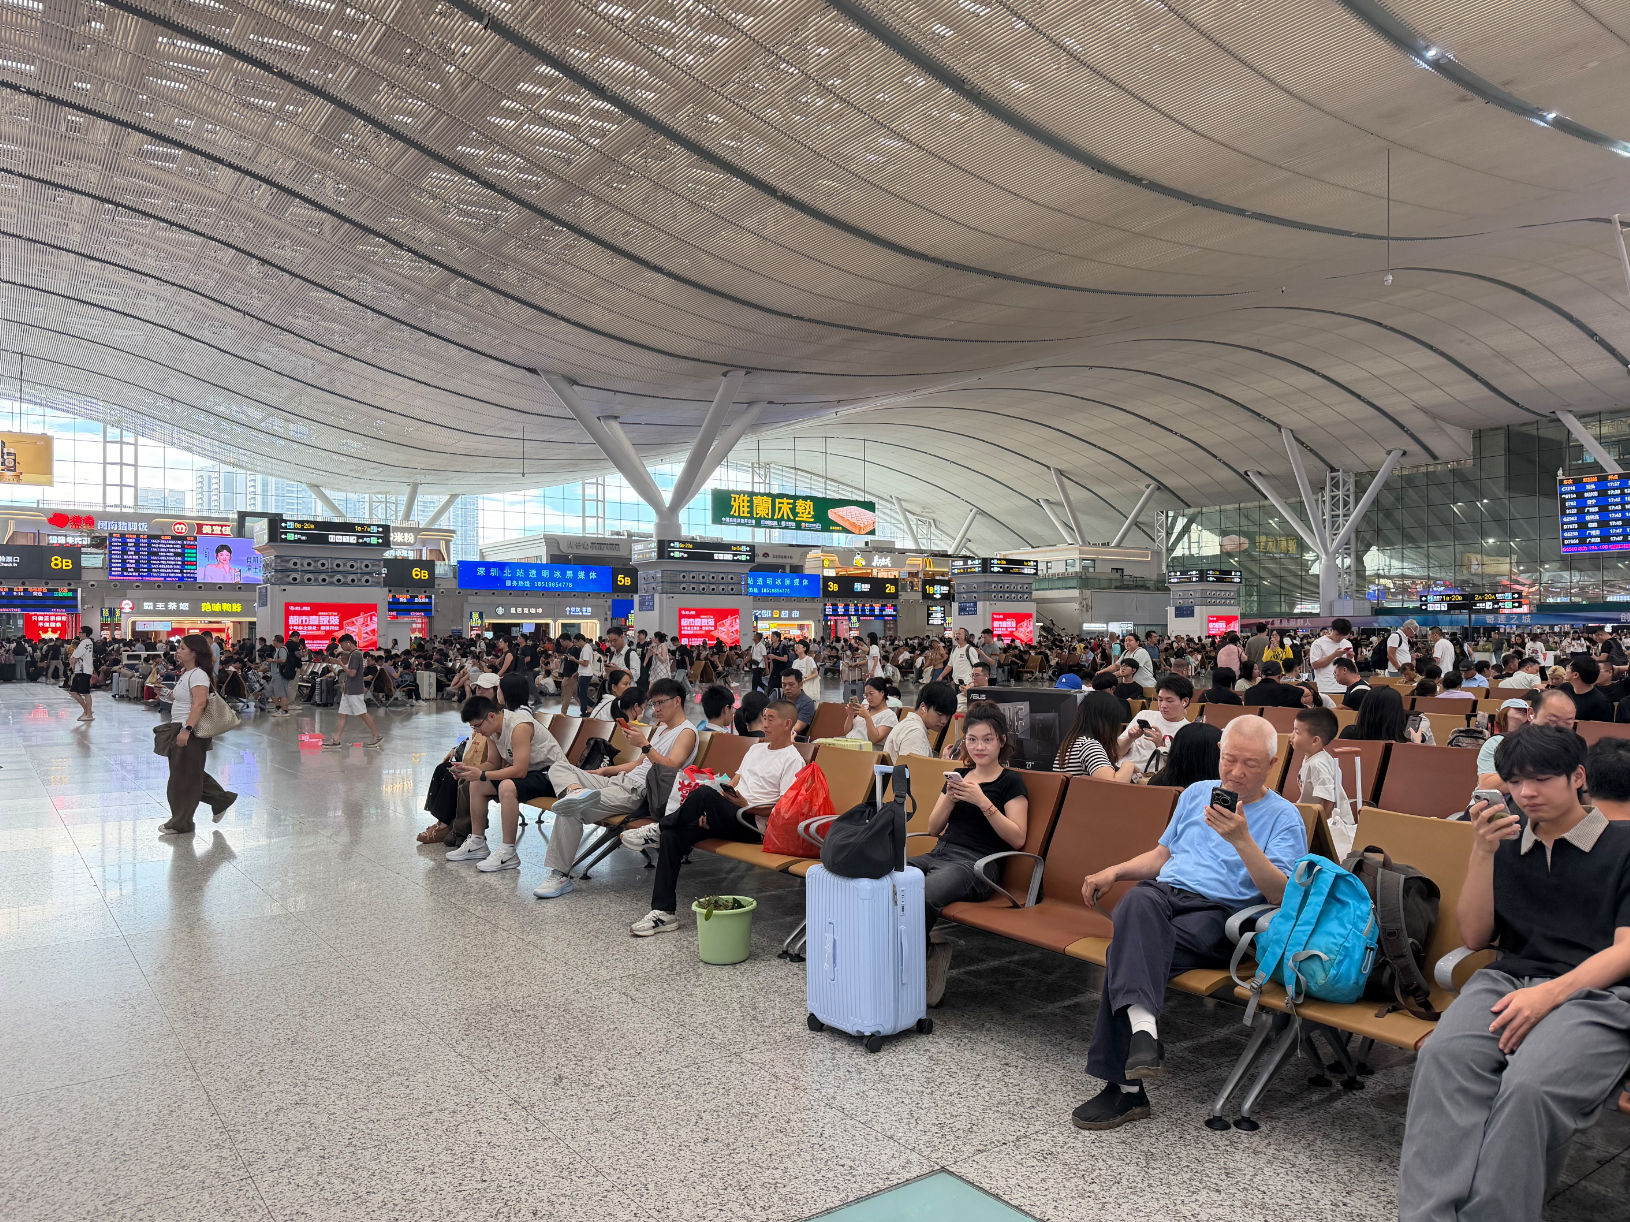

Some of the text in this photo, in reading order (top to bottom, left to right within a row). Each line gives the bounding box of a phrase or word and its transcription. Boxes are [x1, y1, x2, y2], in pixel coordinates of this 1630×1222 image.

[730, 494, 814, 522] 雅蘭床墊
[98, 520, 148, 531] 闽南猪脚饭
[51, 556, 72, 569] 8B
[412, 568, 429, 579] 6B
[476, 567, 597, 580] 深圳北站透明冰屏媒体
[618, 575, 631, 585] 5B
[828, 582, 839, 592] 3B
[886, 584, 896, 593] 2B
[926, 585, 934, 594] 1B
[143, 602, 189, 610] 霸王茶姬
[201, 602, 242, 612] 绝味鸭脖
